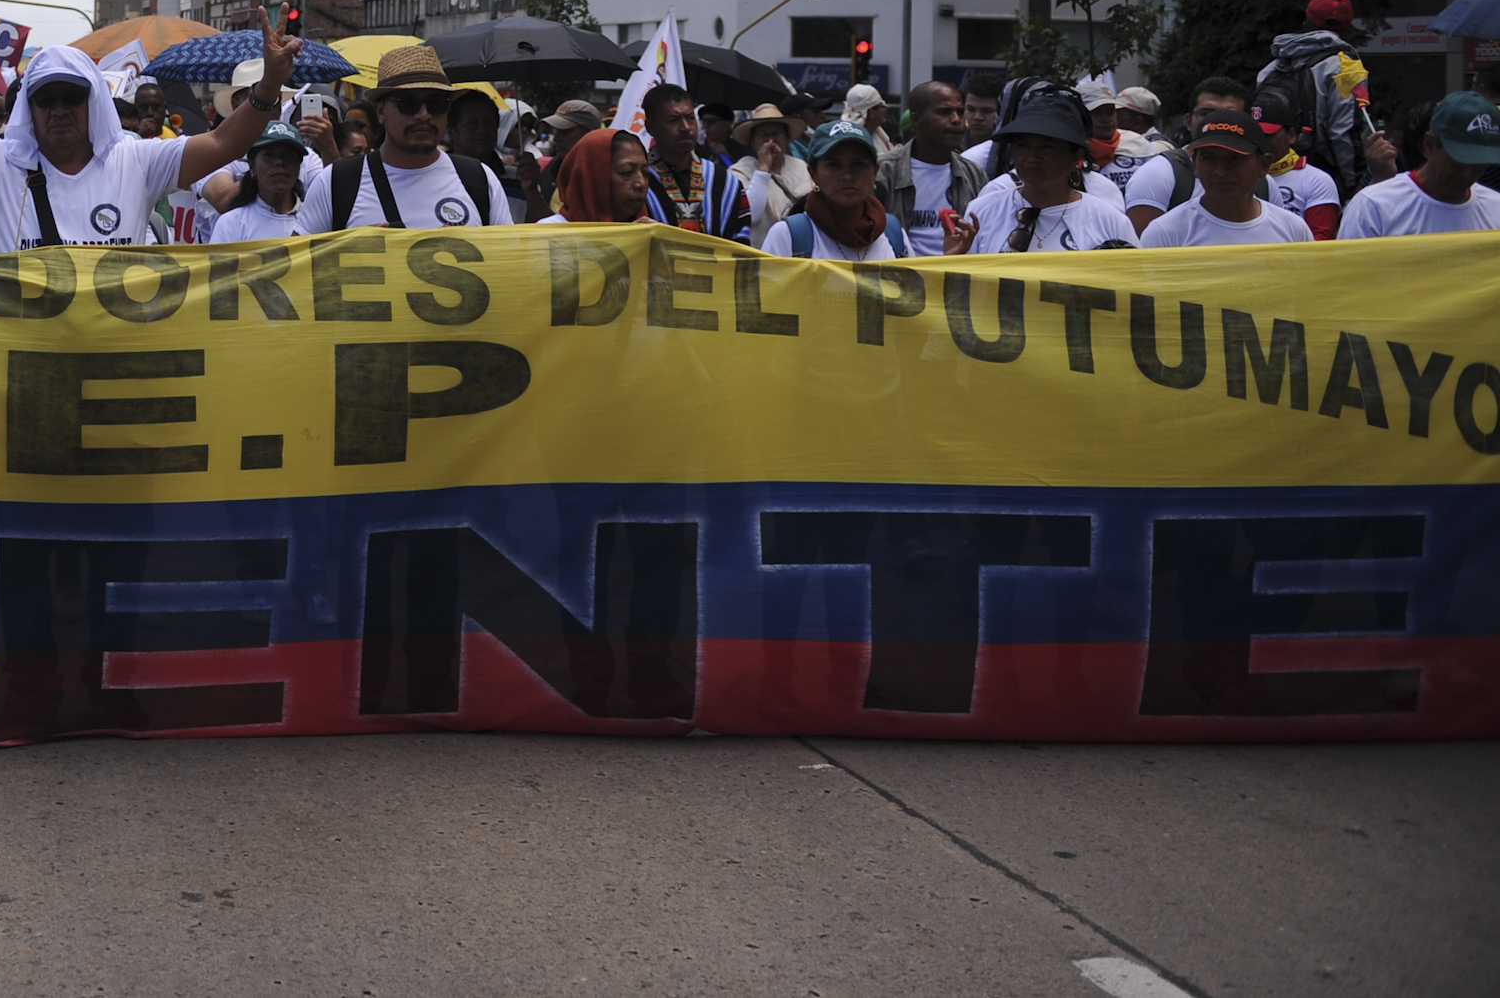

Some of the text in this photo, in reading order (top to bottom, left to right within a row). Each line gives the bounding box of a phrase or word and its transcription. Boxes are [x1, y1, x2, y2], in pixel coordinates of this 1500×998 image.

[792, 65, 837, 90] Spring
[548, 236, 799, 336] DEL
[852, 262, 1500, 454] PUTUMAYO
